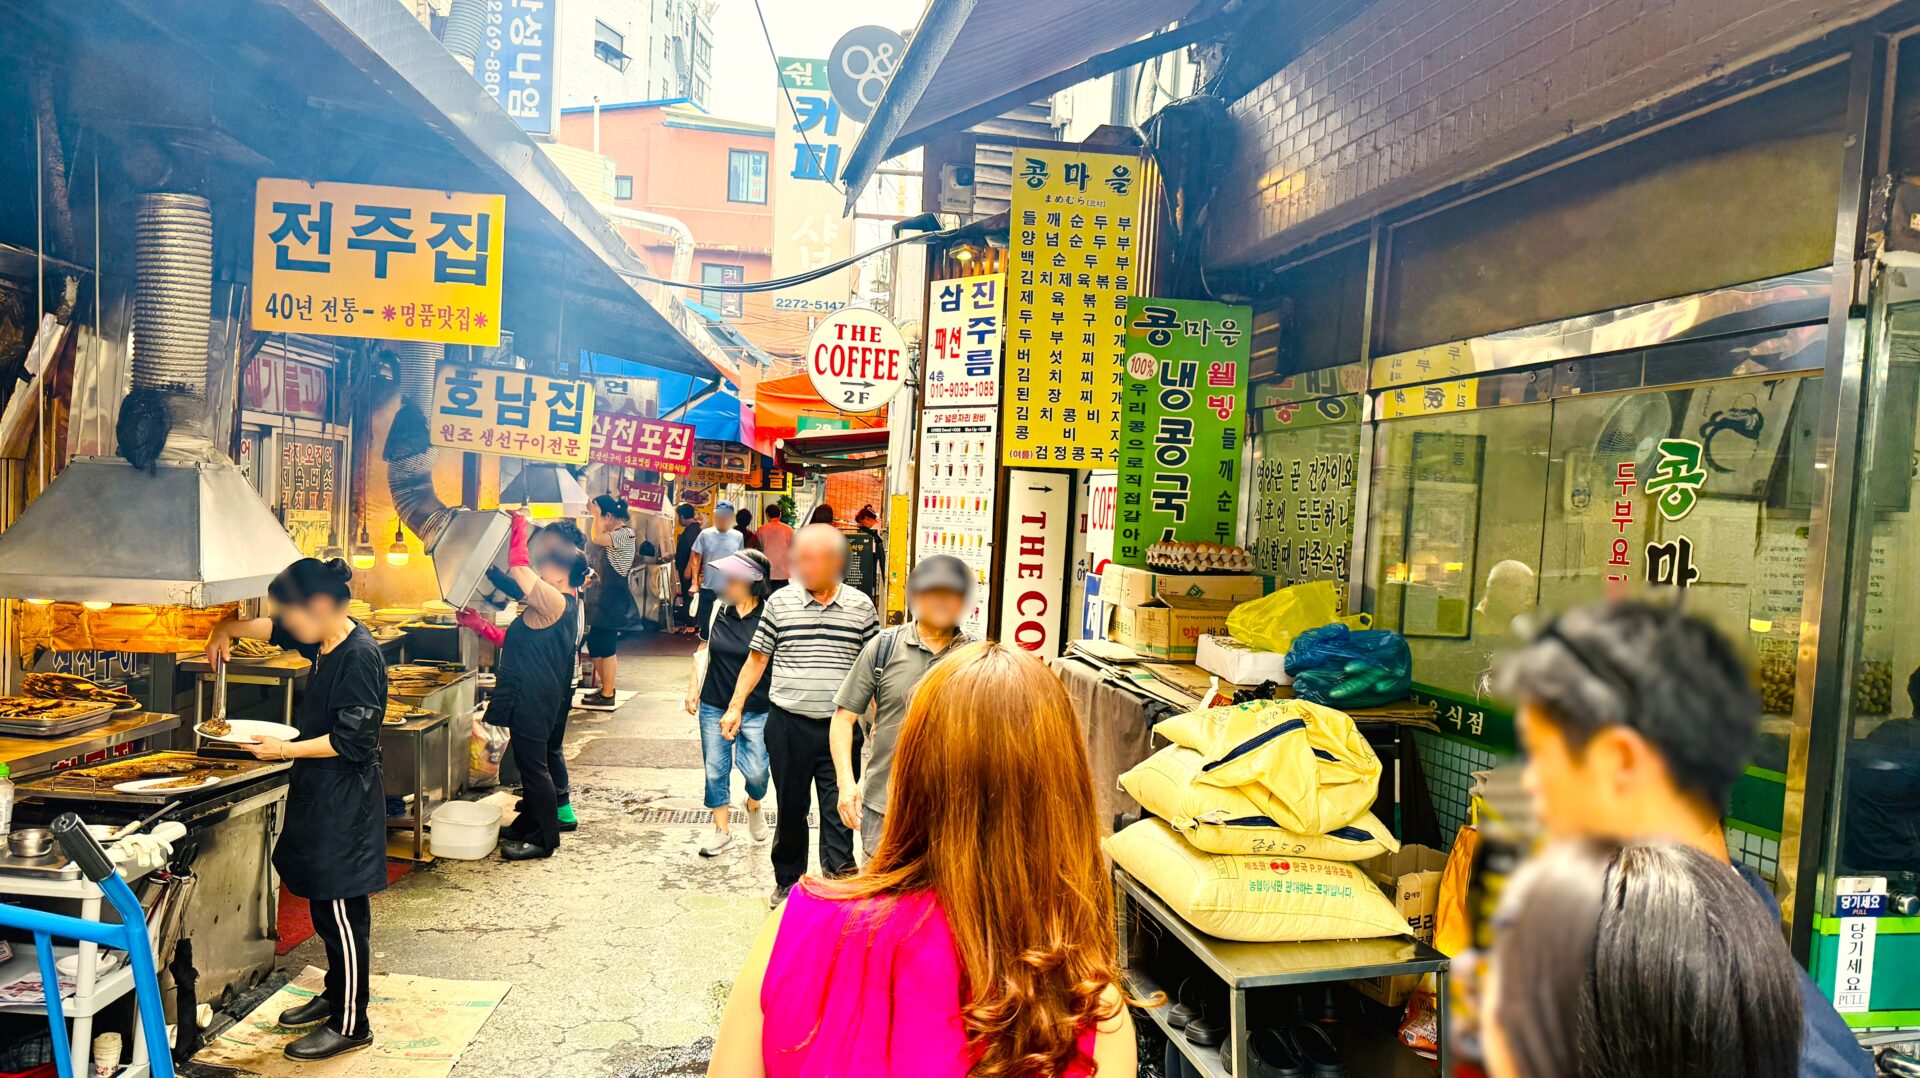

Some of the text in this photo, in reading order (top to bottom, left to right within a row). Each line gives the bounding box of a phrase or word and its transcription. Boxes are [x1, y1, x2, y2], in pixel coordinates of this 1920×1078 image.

[1020, 157, 1134, 194] 콩마을
[1022, 209, 1132, 232] 들깨순두부
[268, 201, 490, 286] 전주집
[1021, 229, 1131, 251] 양념순두부
[1020, 249, 1130, 271] 백순두부
[1020, 269, 1129, 291] 김치제육볶음
[776, 299, 846, 311] 2272-5147
[1020, 289, 1128, 310] 제육볶음
[265, 293, 313, 322] 40년
[400, 303, 470, 332] 명품맛집
[1018, 309, 1127, 329] 두부구이
[834, 323, 882, 343] THE
[1134, 307, 1241, 347] 콩마을
[934, 326, 962, 360] 패션
[1018, 329, 1126, 349] 두부찌개
[814, 343, 900, 381] COFFEE
[1017, 348, 1125, 368] 버섯찌개
[1129, 357, 1155, 378] 100%
[928, 371, 945, 382] 4층
[1016, 367, 1123, 387] 김치찌개
[843, 390, 870, 404] 2F
[930, 381, 994, 398] 010-9039-1088
[1206, 361, 1236, 420] 웰빙
[440, 370, 586, 434] 호남집
[440, 423, 581, 457] 원조 생선구이전문
[590, 415, 690, 461] 삼천포집
[1034, 443, 1120, 463] 검정콩국수
[1256, 458, 1284, 493] 영양은
[1296, 498, 1351, 537] 든든하니
[1608, 462, 1637, 590] 두부요
[1014, 511, 1048, 664] THE CO
[1840, 894, 1880, 909] 당기세요
[1844, 922, 1866, 991] 당기세요
[1837, 994, 1866, 1006] PULL
